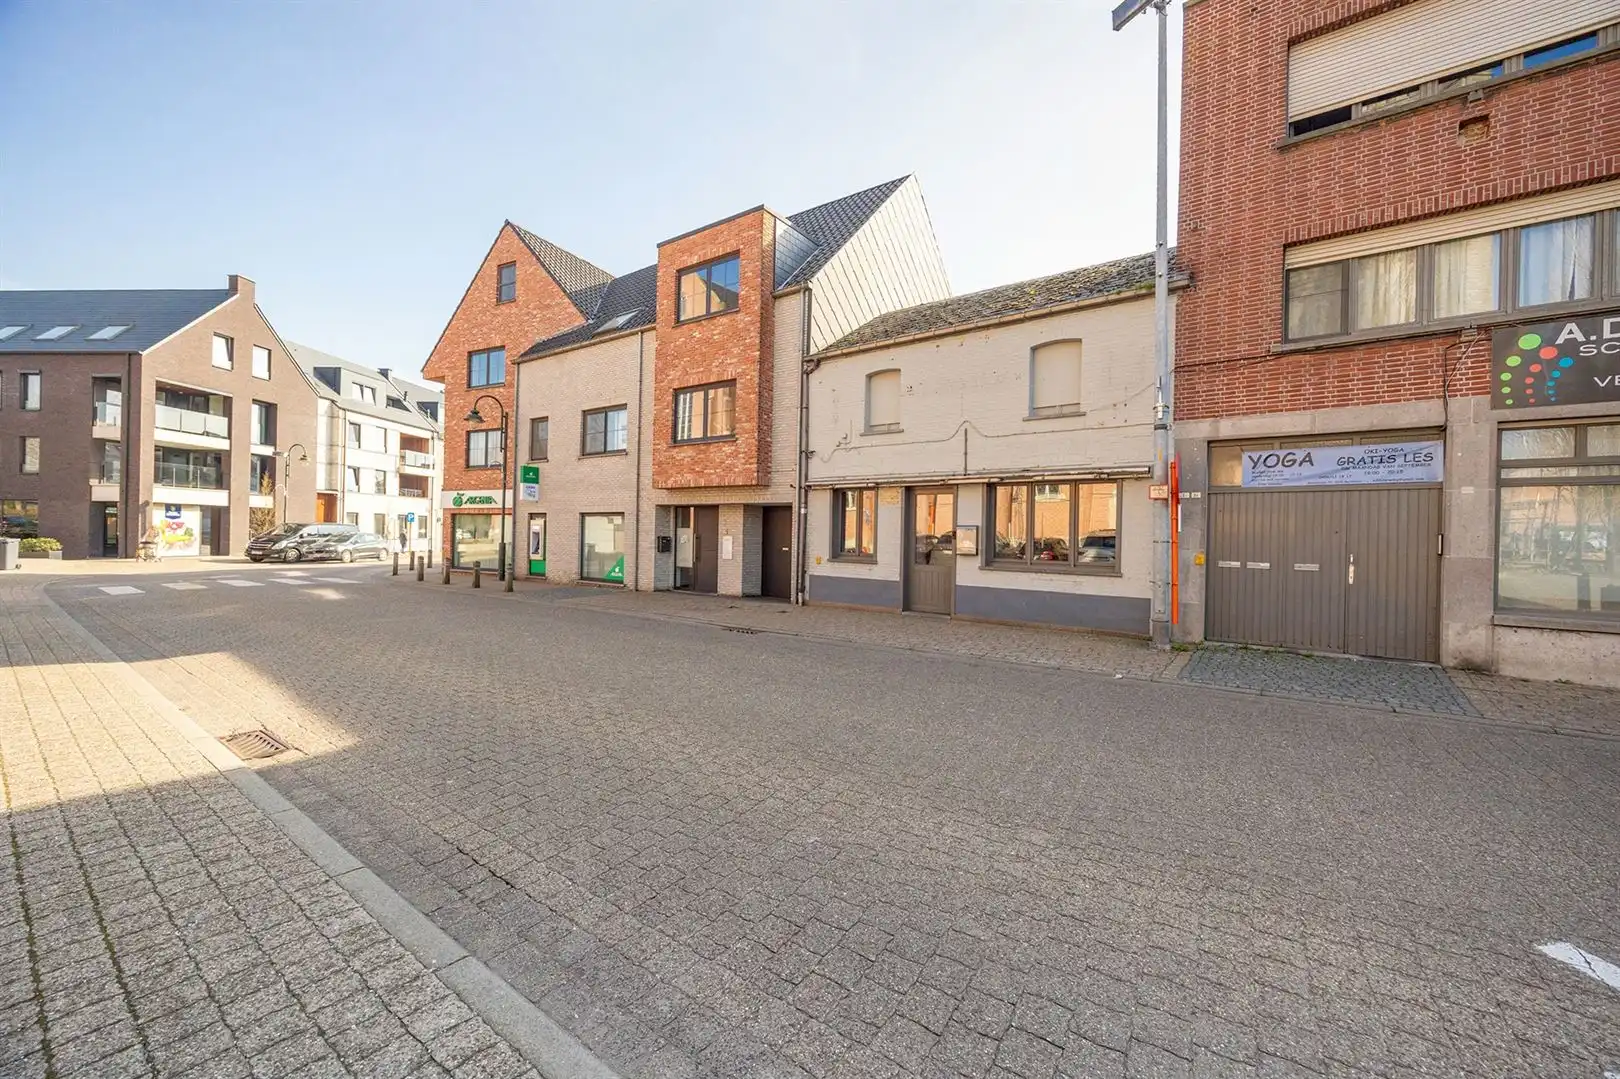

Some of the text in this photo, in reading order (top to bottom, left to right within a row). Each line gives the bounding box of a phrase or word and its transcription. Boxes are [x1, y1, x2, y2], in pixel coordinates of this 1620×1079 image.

[1364, 447, 1405, 455] OKI-YOGA
[1247, 452, 1314, 469] YOGA
[1337, 452, 1434, 466] GRATIS LES
